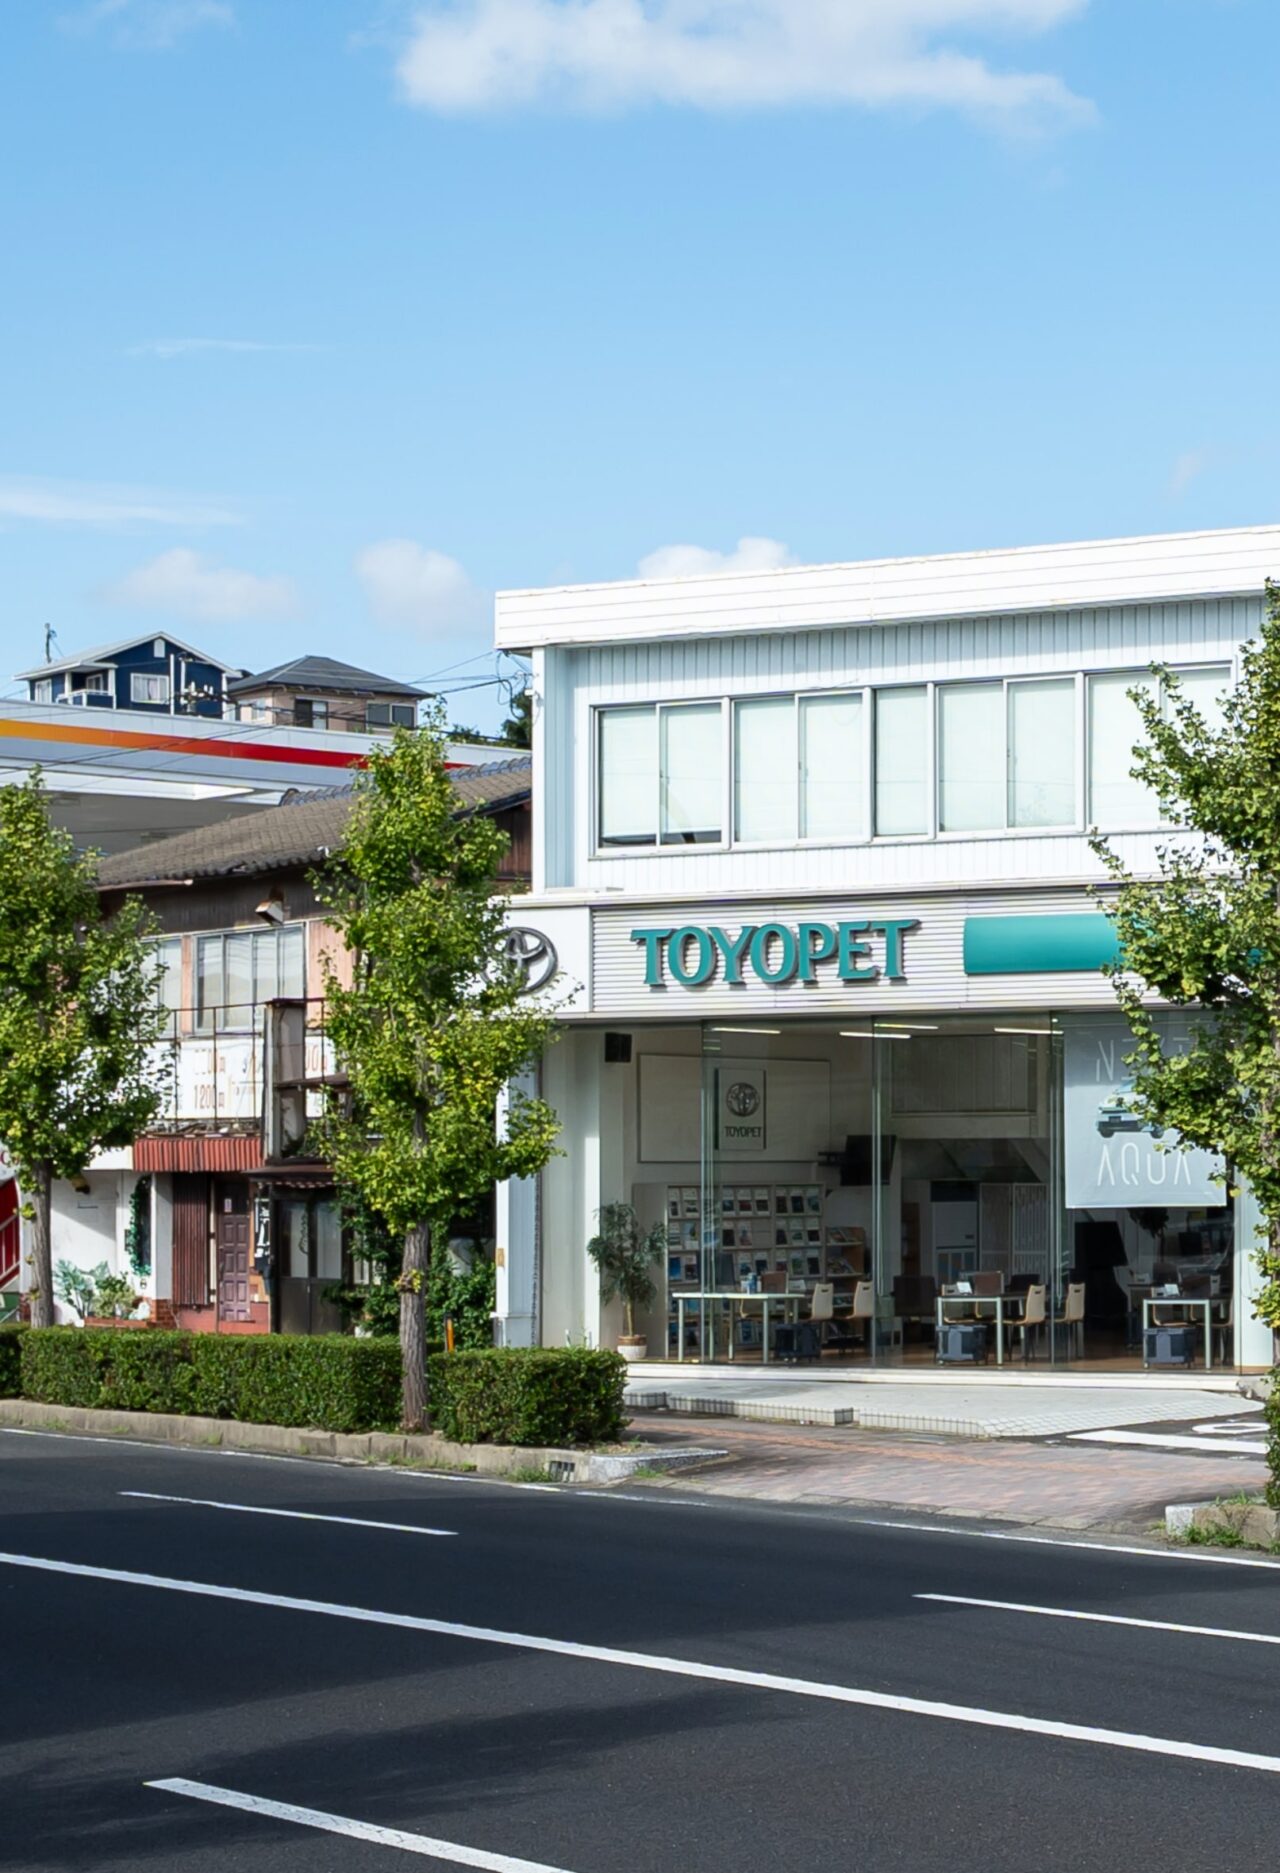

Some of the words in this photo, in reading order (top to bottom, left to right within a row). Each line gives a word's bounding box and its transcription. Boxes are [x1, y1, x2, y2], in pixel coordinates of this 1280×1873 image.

[630, 918, 921, 988] TOYOPET
[724, 1125, 763, 1138] TOYOPET
[1096, 1142, 1192, 1187] AQUA
